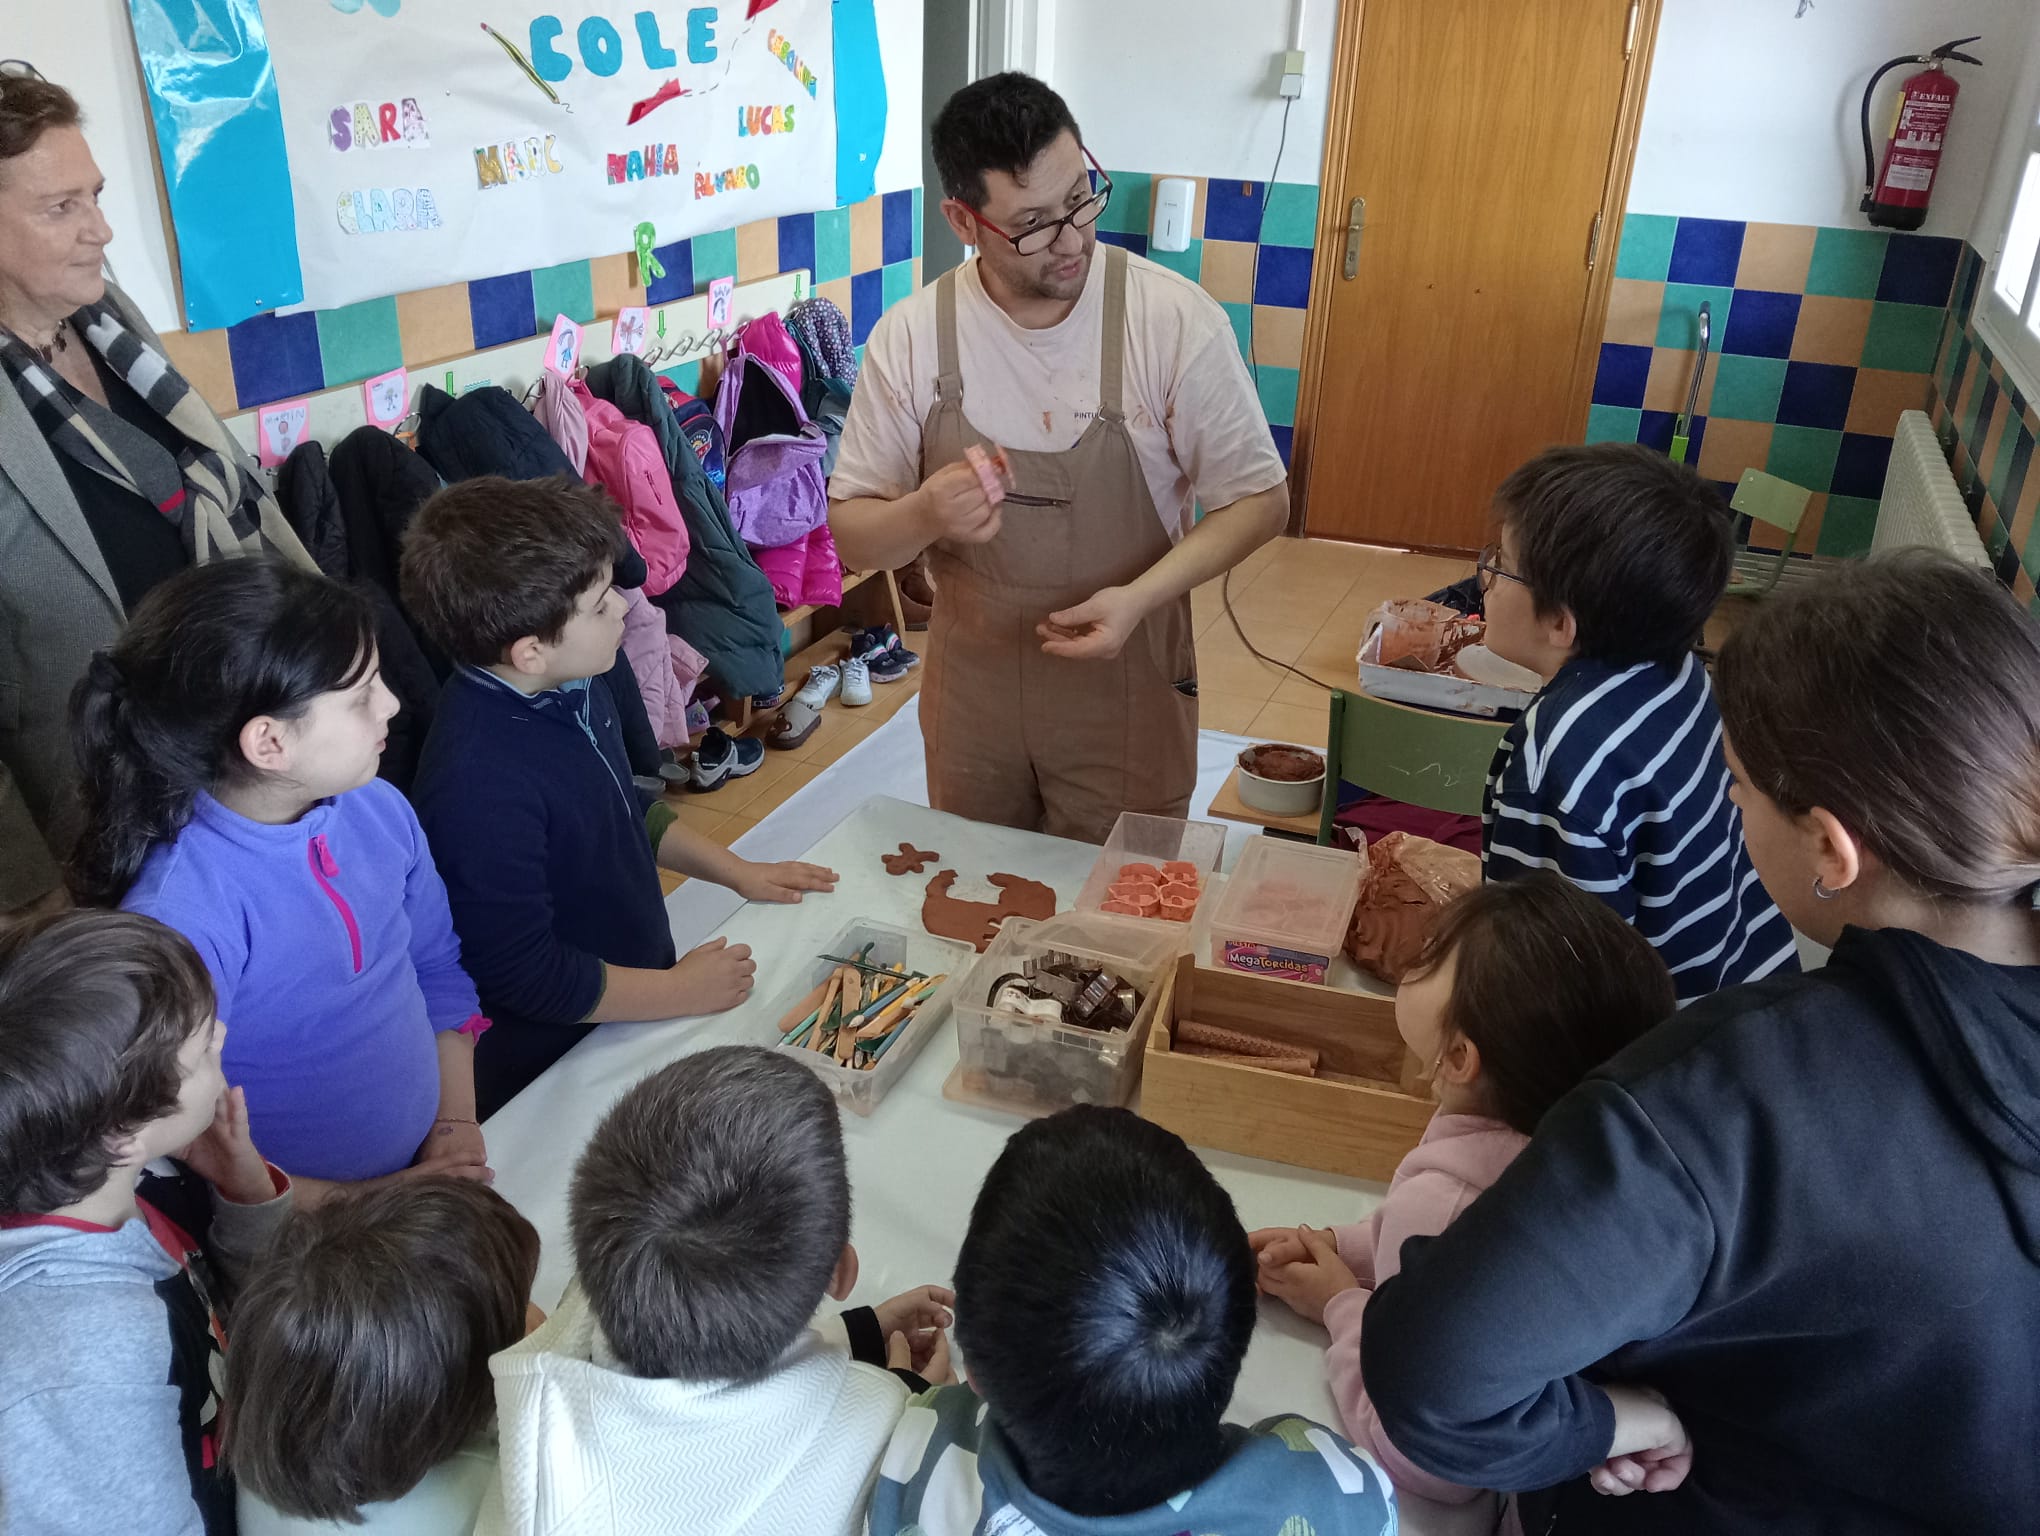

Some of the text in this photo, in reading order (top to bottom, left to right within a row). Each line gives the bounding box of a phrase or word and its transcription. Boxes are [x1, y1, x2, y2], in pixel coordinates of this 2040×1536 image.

[529, 7, 718, 82] COLE
[329, 98, 429, 152] SARA
[738, 104, 795, 137] LUCAS
[606, 143, 680, 185] NAHIA
[336, 188, 442, 235] CLARA
